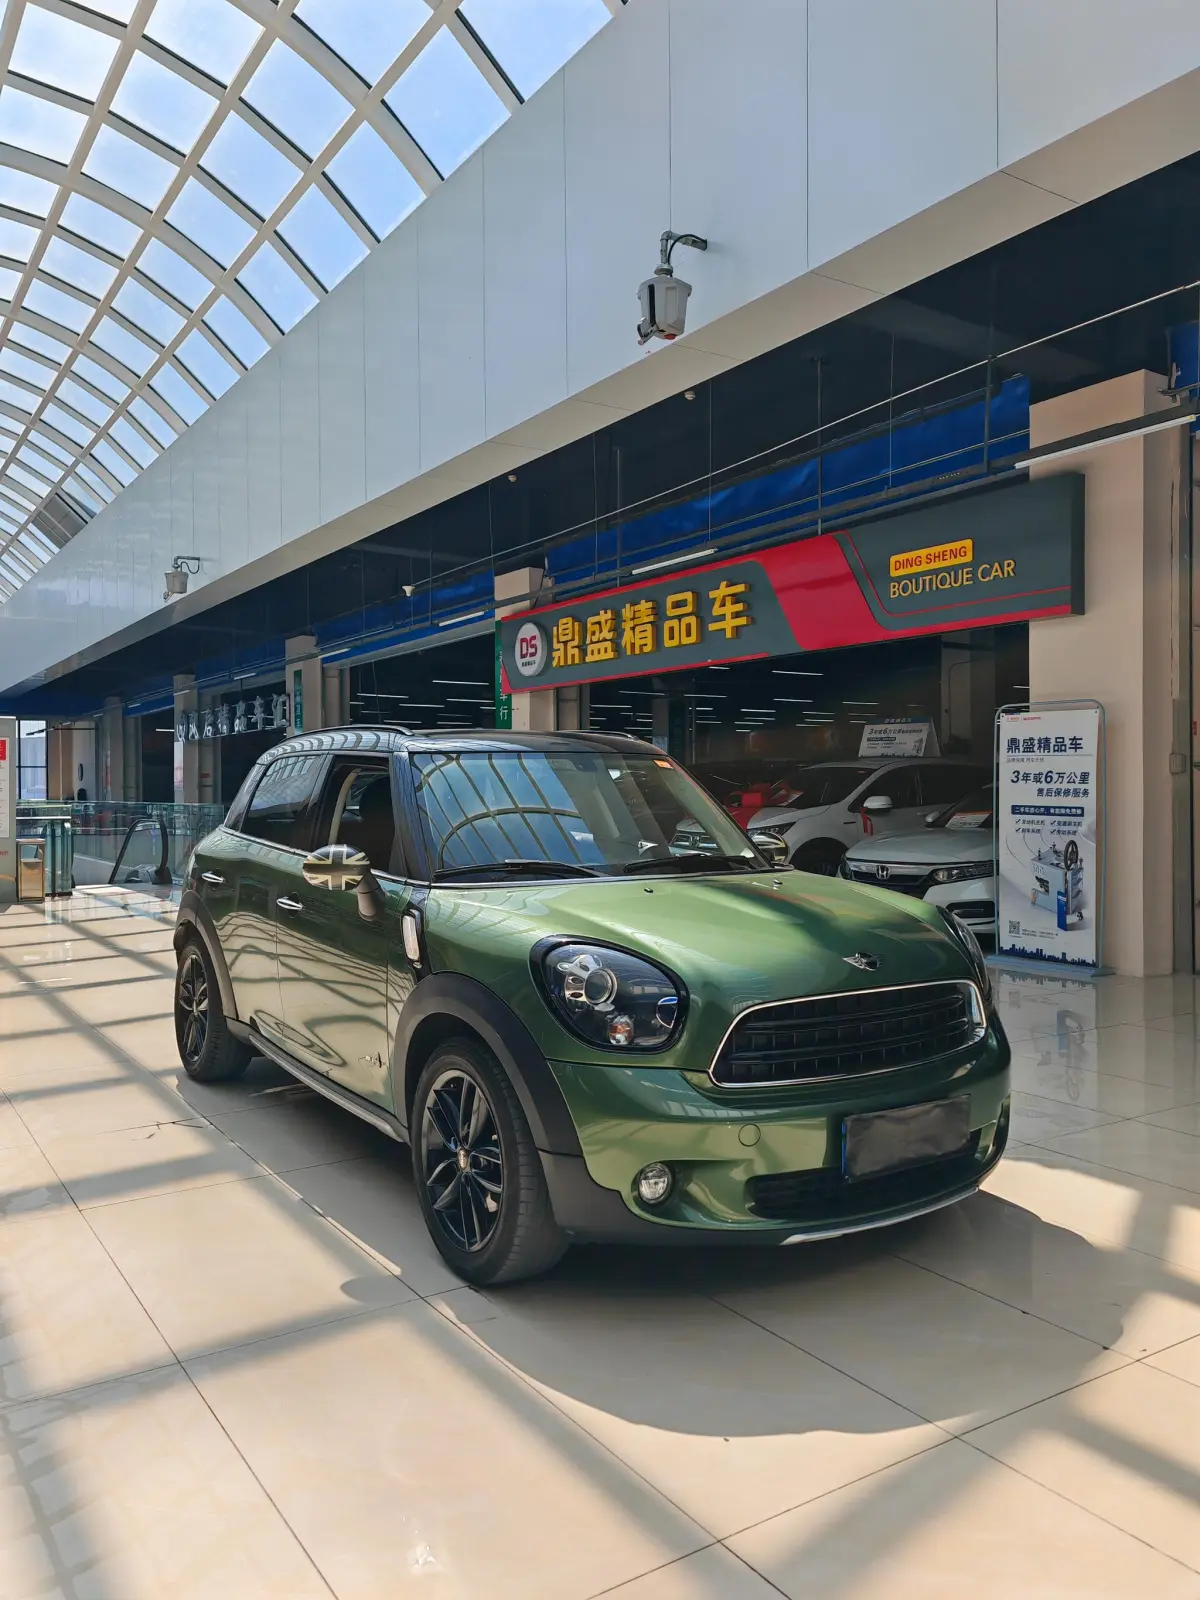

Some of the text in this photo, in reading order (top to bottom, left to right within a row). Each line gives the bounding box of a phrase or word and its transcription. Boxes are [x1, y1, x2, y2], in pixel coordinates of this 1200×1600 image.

[894, 545, 968, 572] DING SHENG
[890, 559, 1016, 599] BOUTIQUE CAR
[552, 580, 752, 668] 鼎盛精品车
[520, 635, 537, 659] DS
[1006, 736, 1084, 754] 鼎盛精品车
[1011, 770, 1090, 785] 3年或6万公里
[1036, 788, 1090, 798] 售后保修服务
